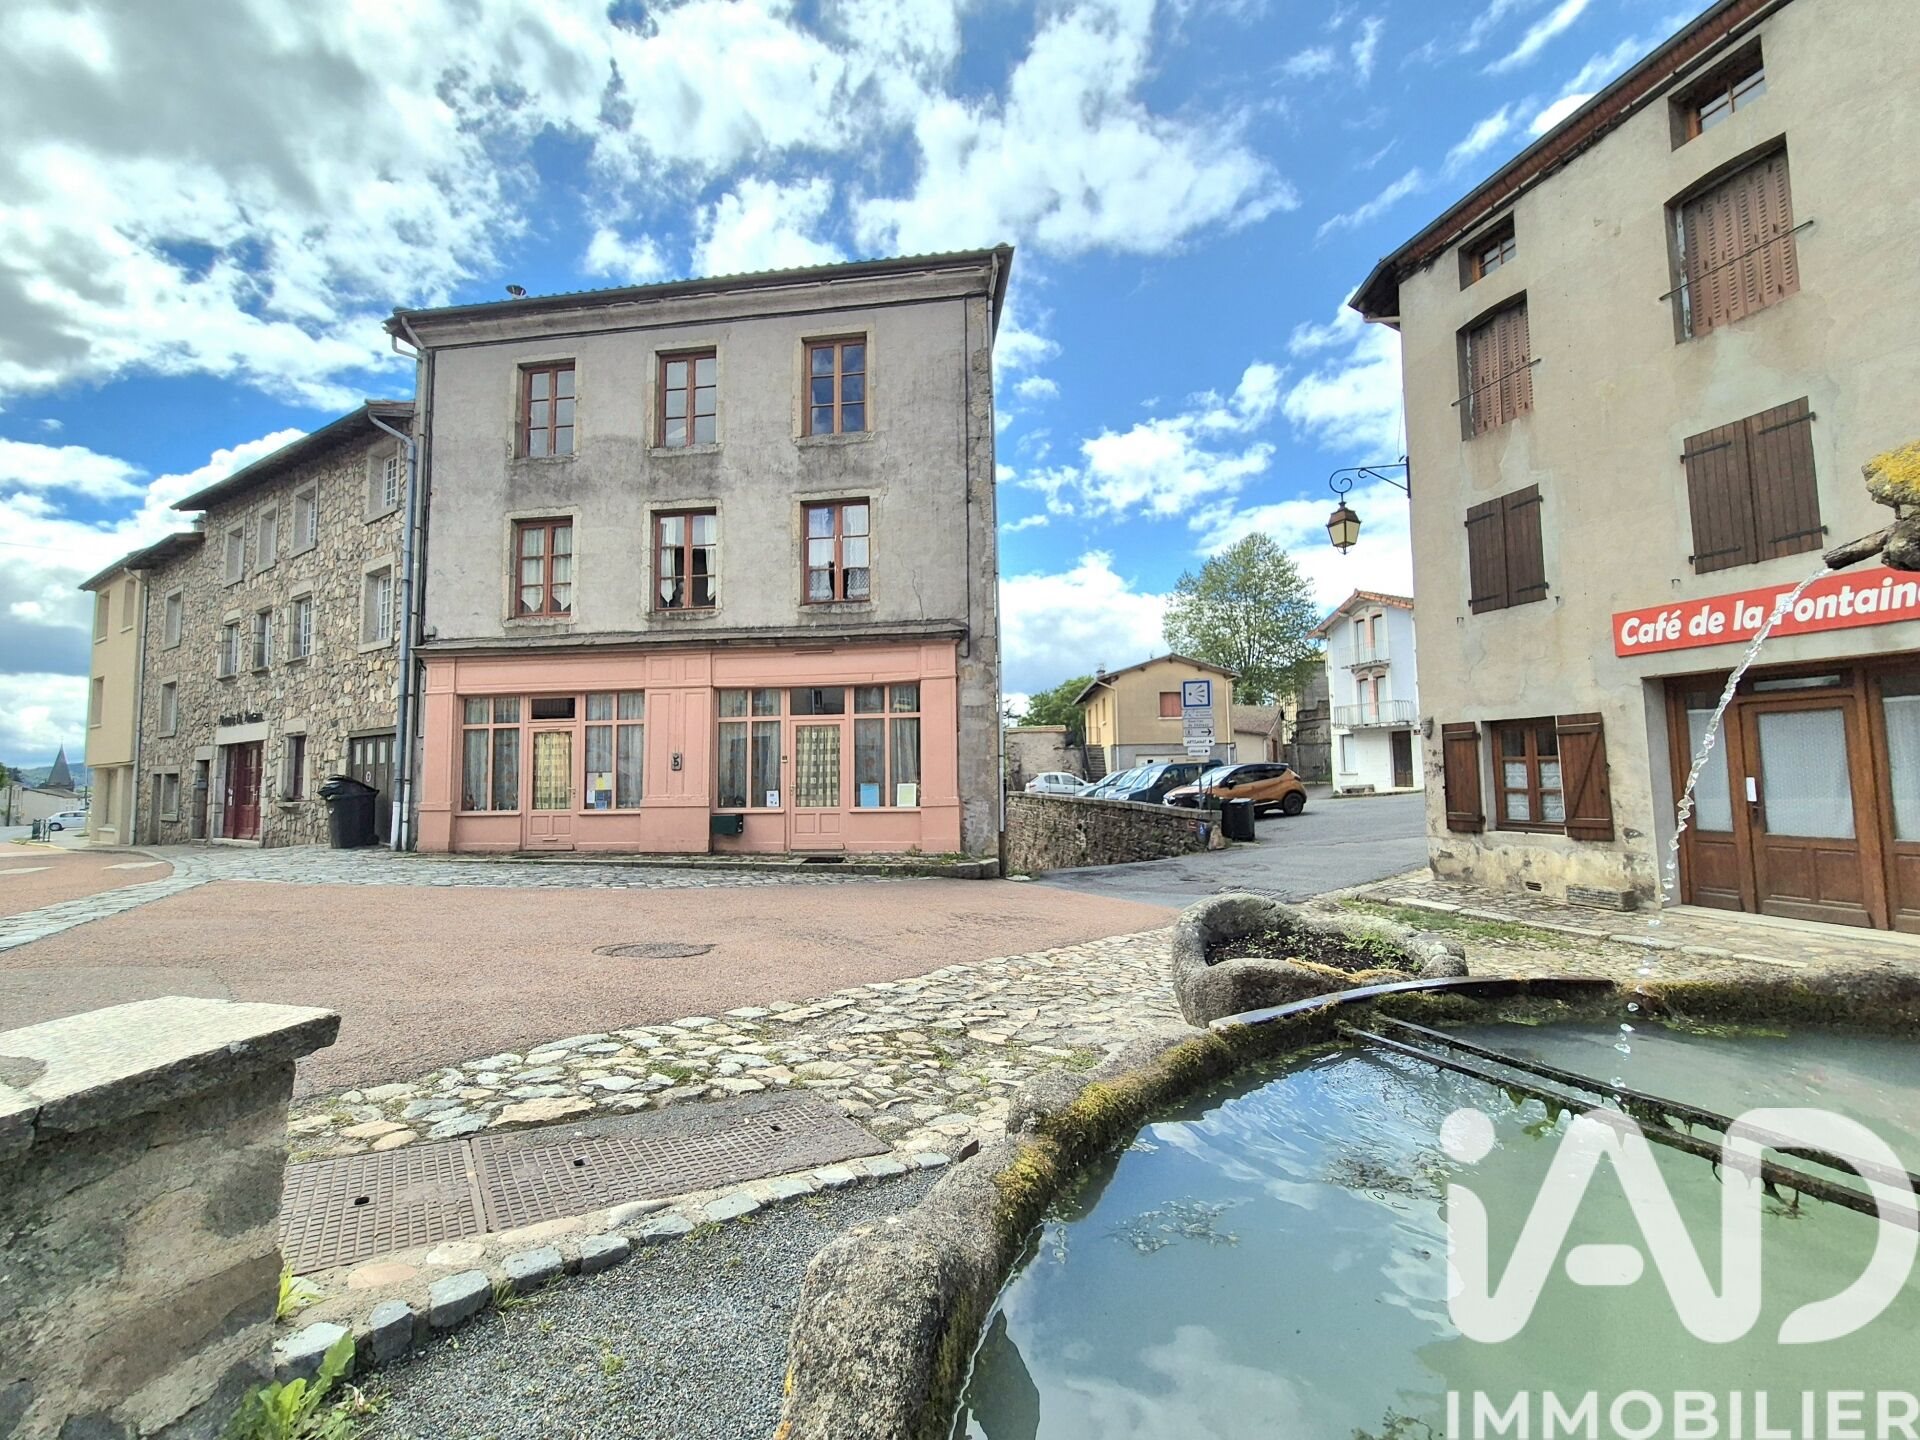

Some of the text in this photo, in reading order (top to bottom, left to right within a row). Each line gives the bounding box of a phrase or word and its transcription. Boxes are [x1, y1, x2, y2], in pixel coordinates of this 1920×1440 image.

[1621, 577, 1920, 646] Café de la Fontain
